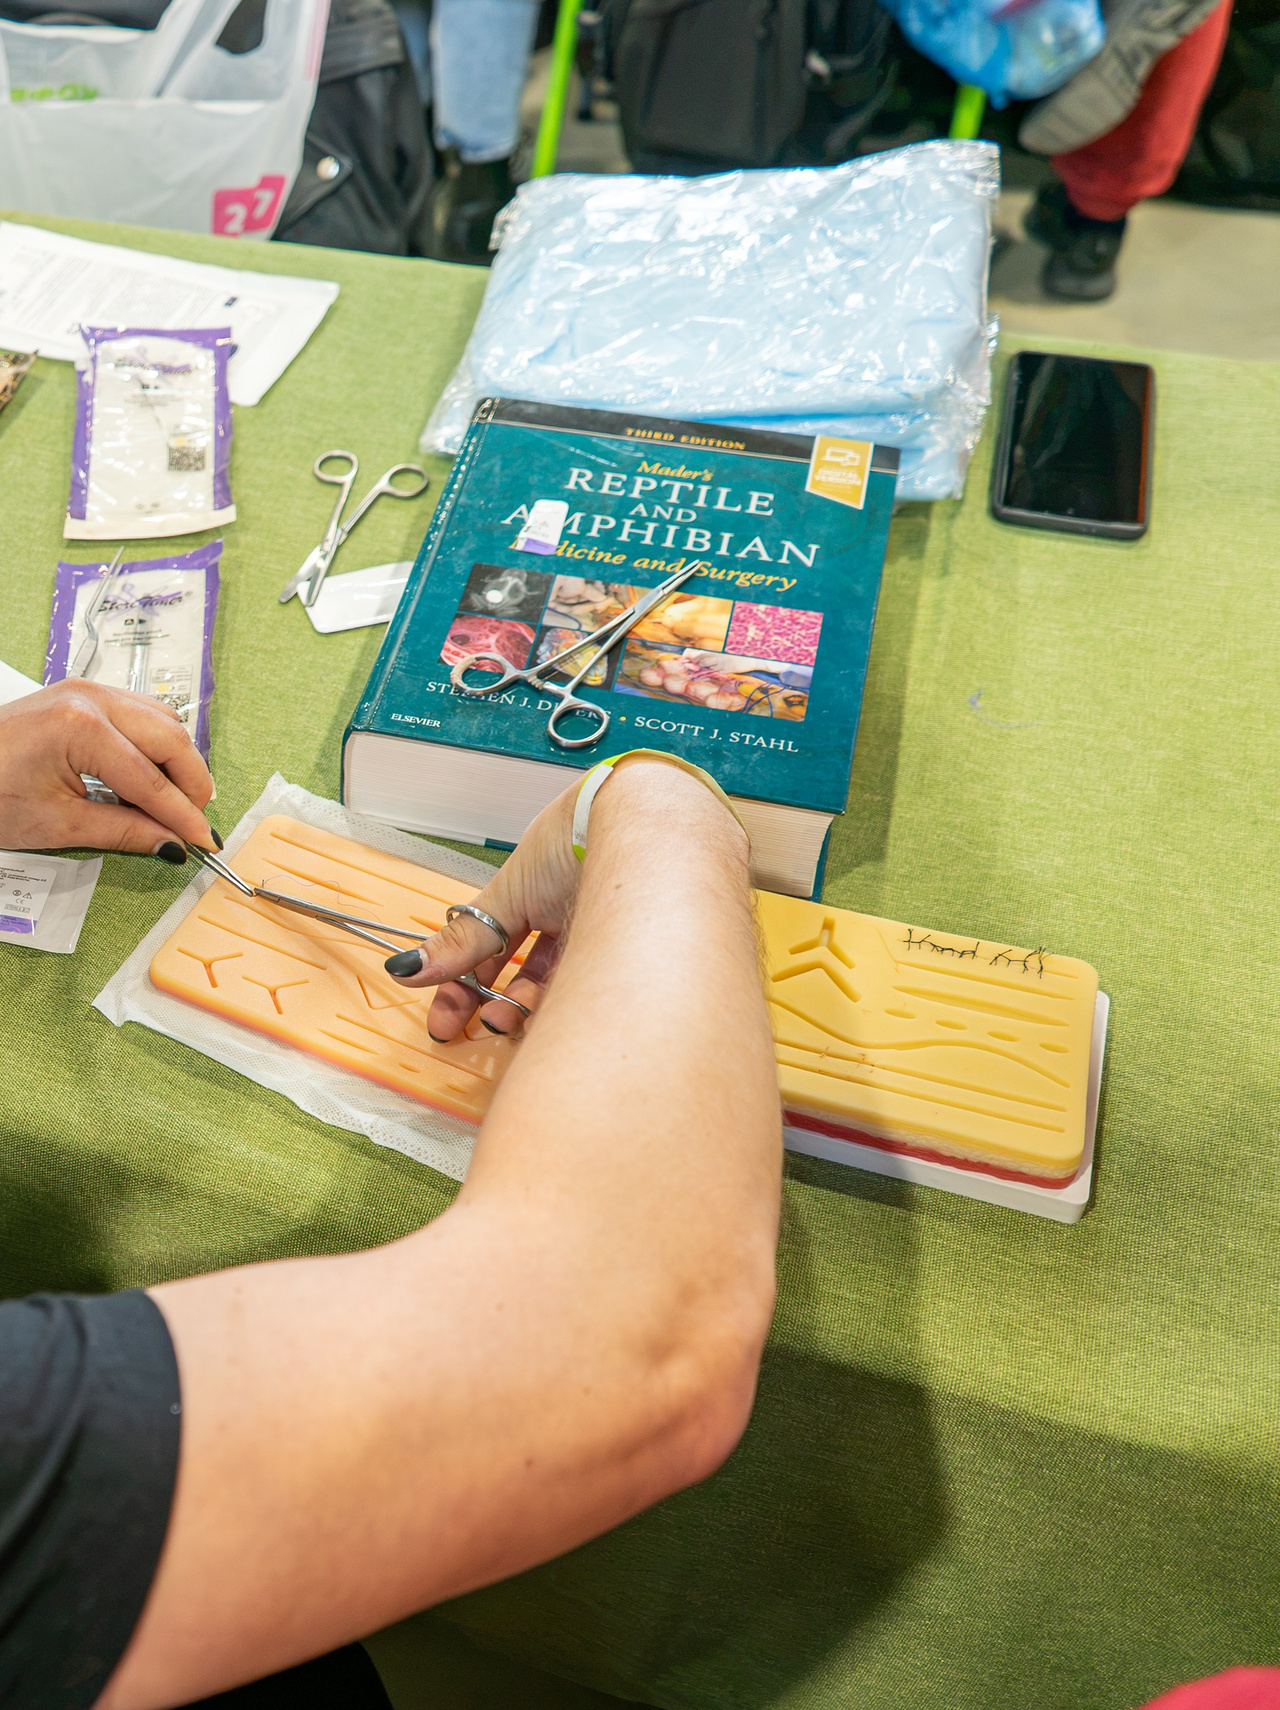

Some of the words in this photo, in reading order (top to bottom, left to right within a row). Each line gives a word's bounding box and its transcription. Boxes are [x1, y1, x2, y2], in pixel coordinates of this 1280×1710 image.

[625, 426, 675, 442] THIRD
[679, 434, 747, 451] EDITION
[636, 459, 715, 483] Mader's
[563, 466, 775, 517] REPTILE
[628, 502, 698, 523] AND
[507, 534, 628, 565] dicine
[632, 557, 687, 574] and
[695, 560, 798, 593] Surgery
[390, 711, 442, 729] ELSEVIER
[425, 680, 516, 706] STEEN
[518, 696, 532, 708] J.
[634, 715, 705, 737] SCOTT
[709, 728, 723, 741] J.
[728, 730, 800, 753] STAHL
